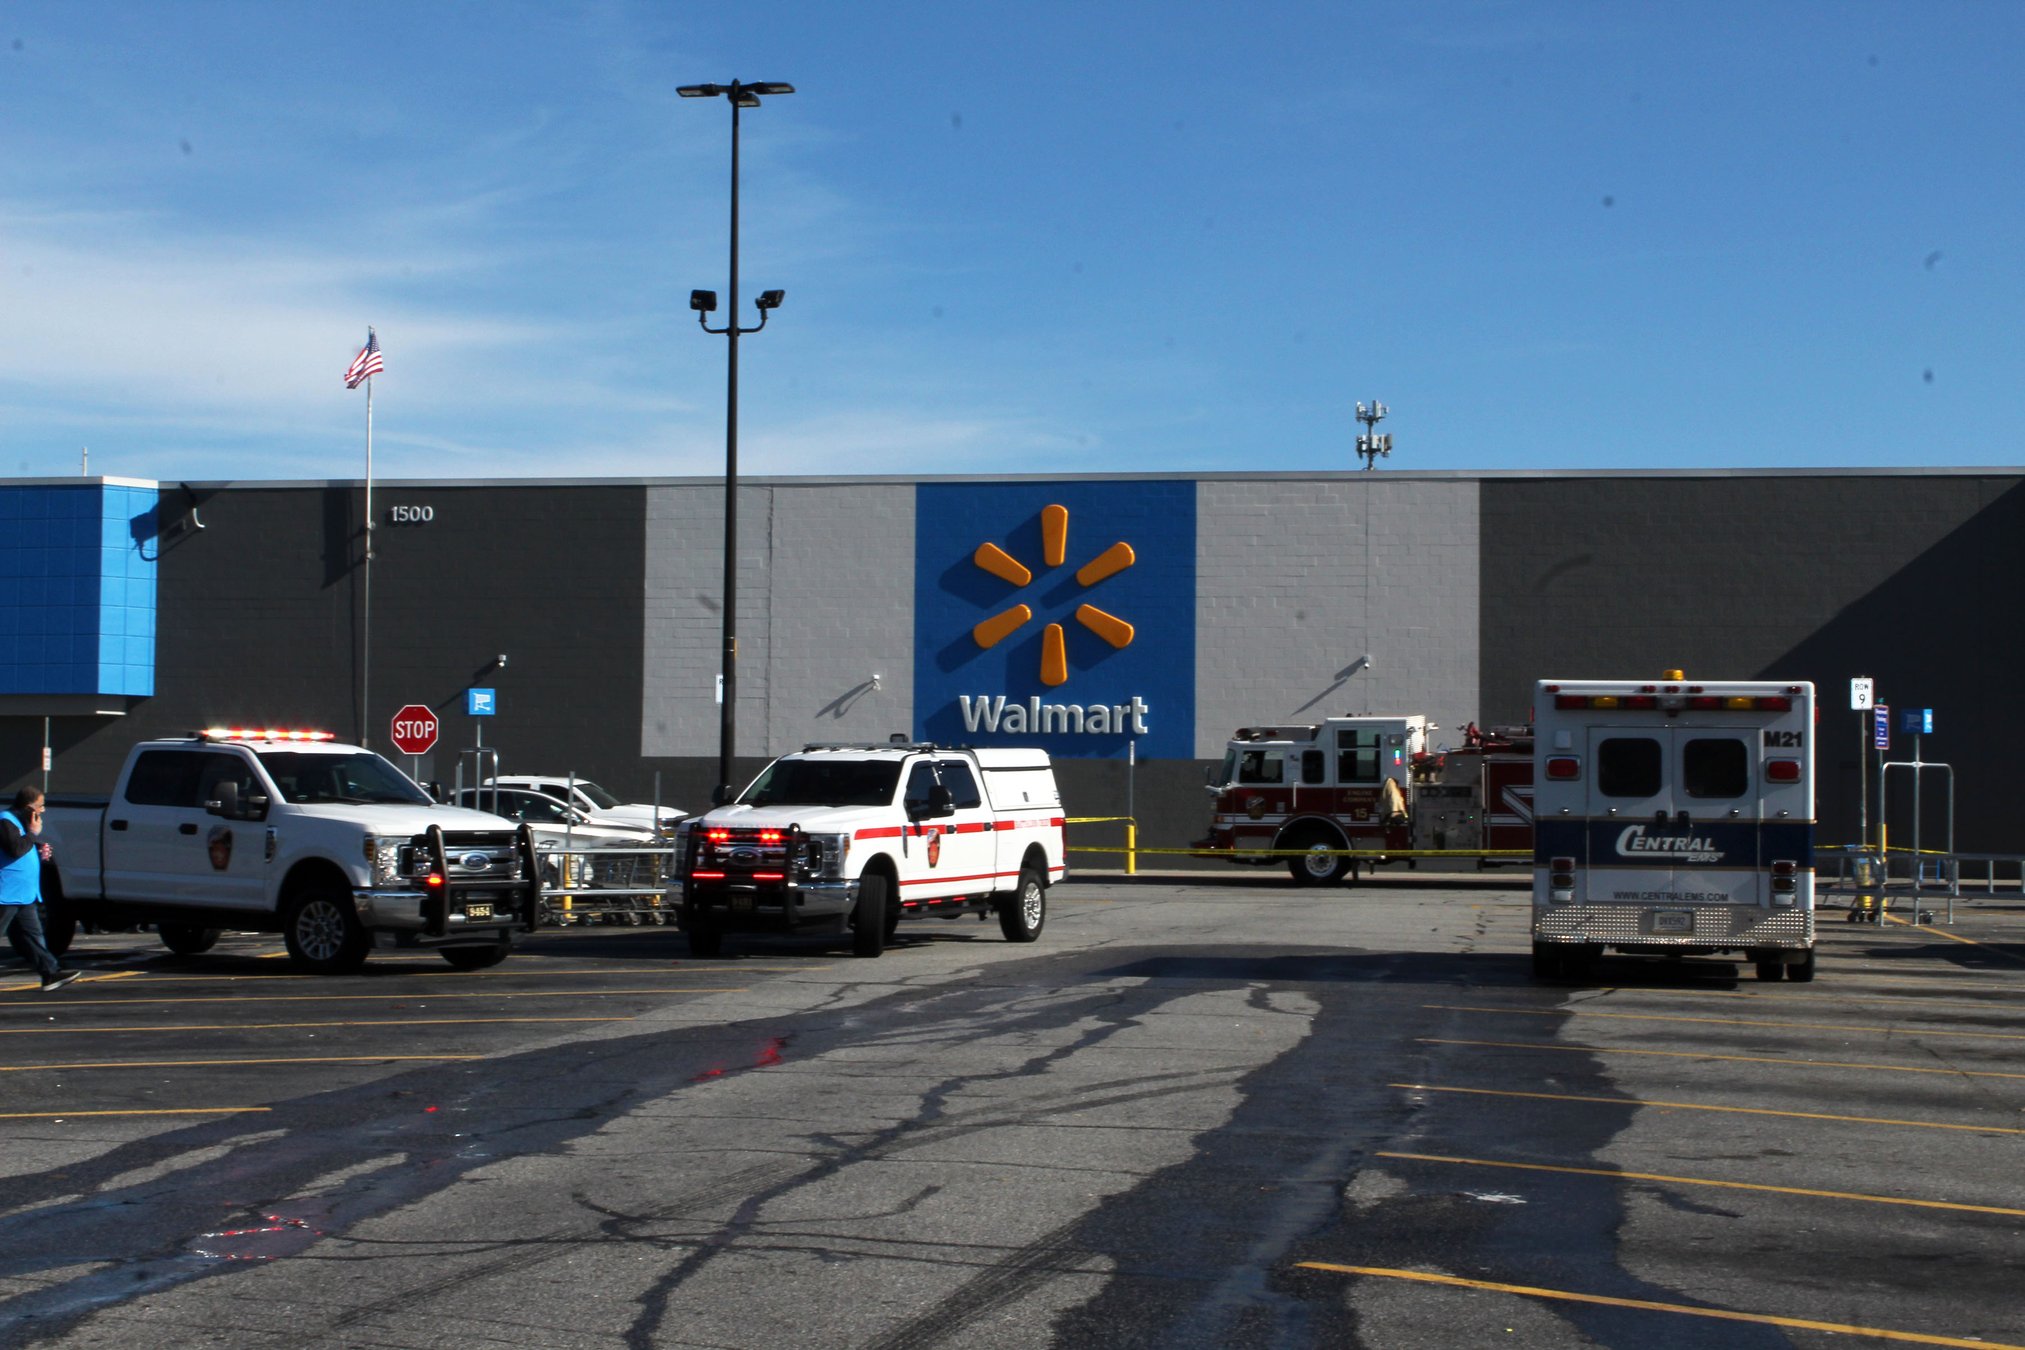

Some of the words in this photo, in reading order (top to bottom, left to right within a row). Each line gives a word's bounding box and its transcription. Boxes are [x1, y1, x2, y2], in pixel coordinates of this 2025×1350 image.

[391, 505, 434, 522] 1500
[1854, 683, 1869, 691] ROW
[1858, 694, 1866, 704] 9
[959, 695, 1148, 734] Walmart
[395, 720, 435, 739] STOP
[1764, 731, 1803, 748] M21
[1354, 808, 1367, 818] 15
[1616, 825, 1719, 857] CENTRAL
[1687, 853, 1719, 862] EMS
[1613, 891, 1729, 902] WWW.CENTRALEMS.COM
